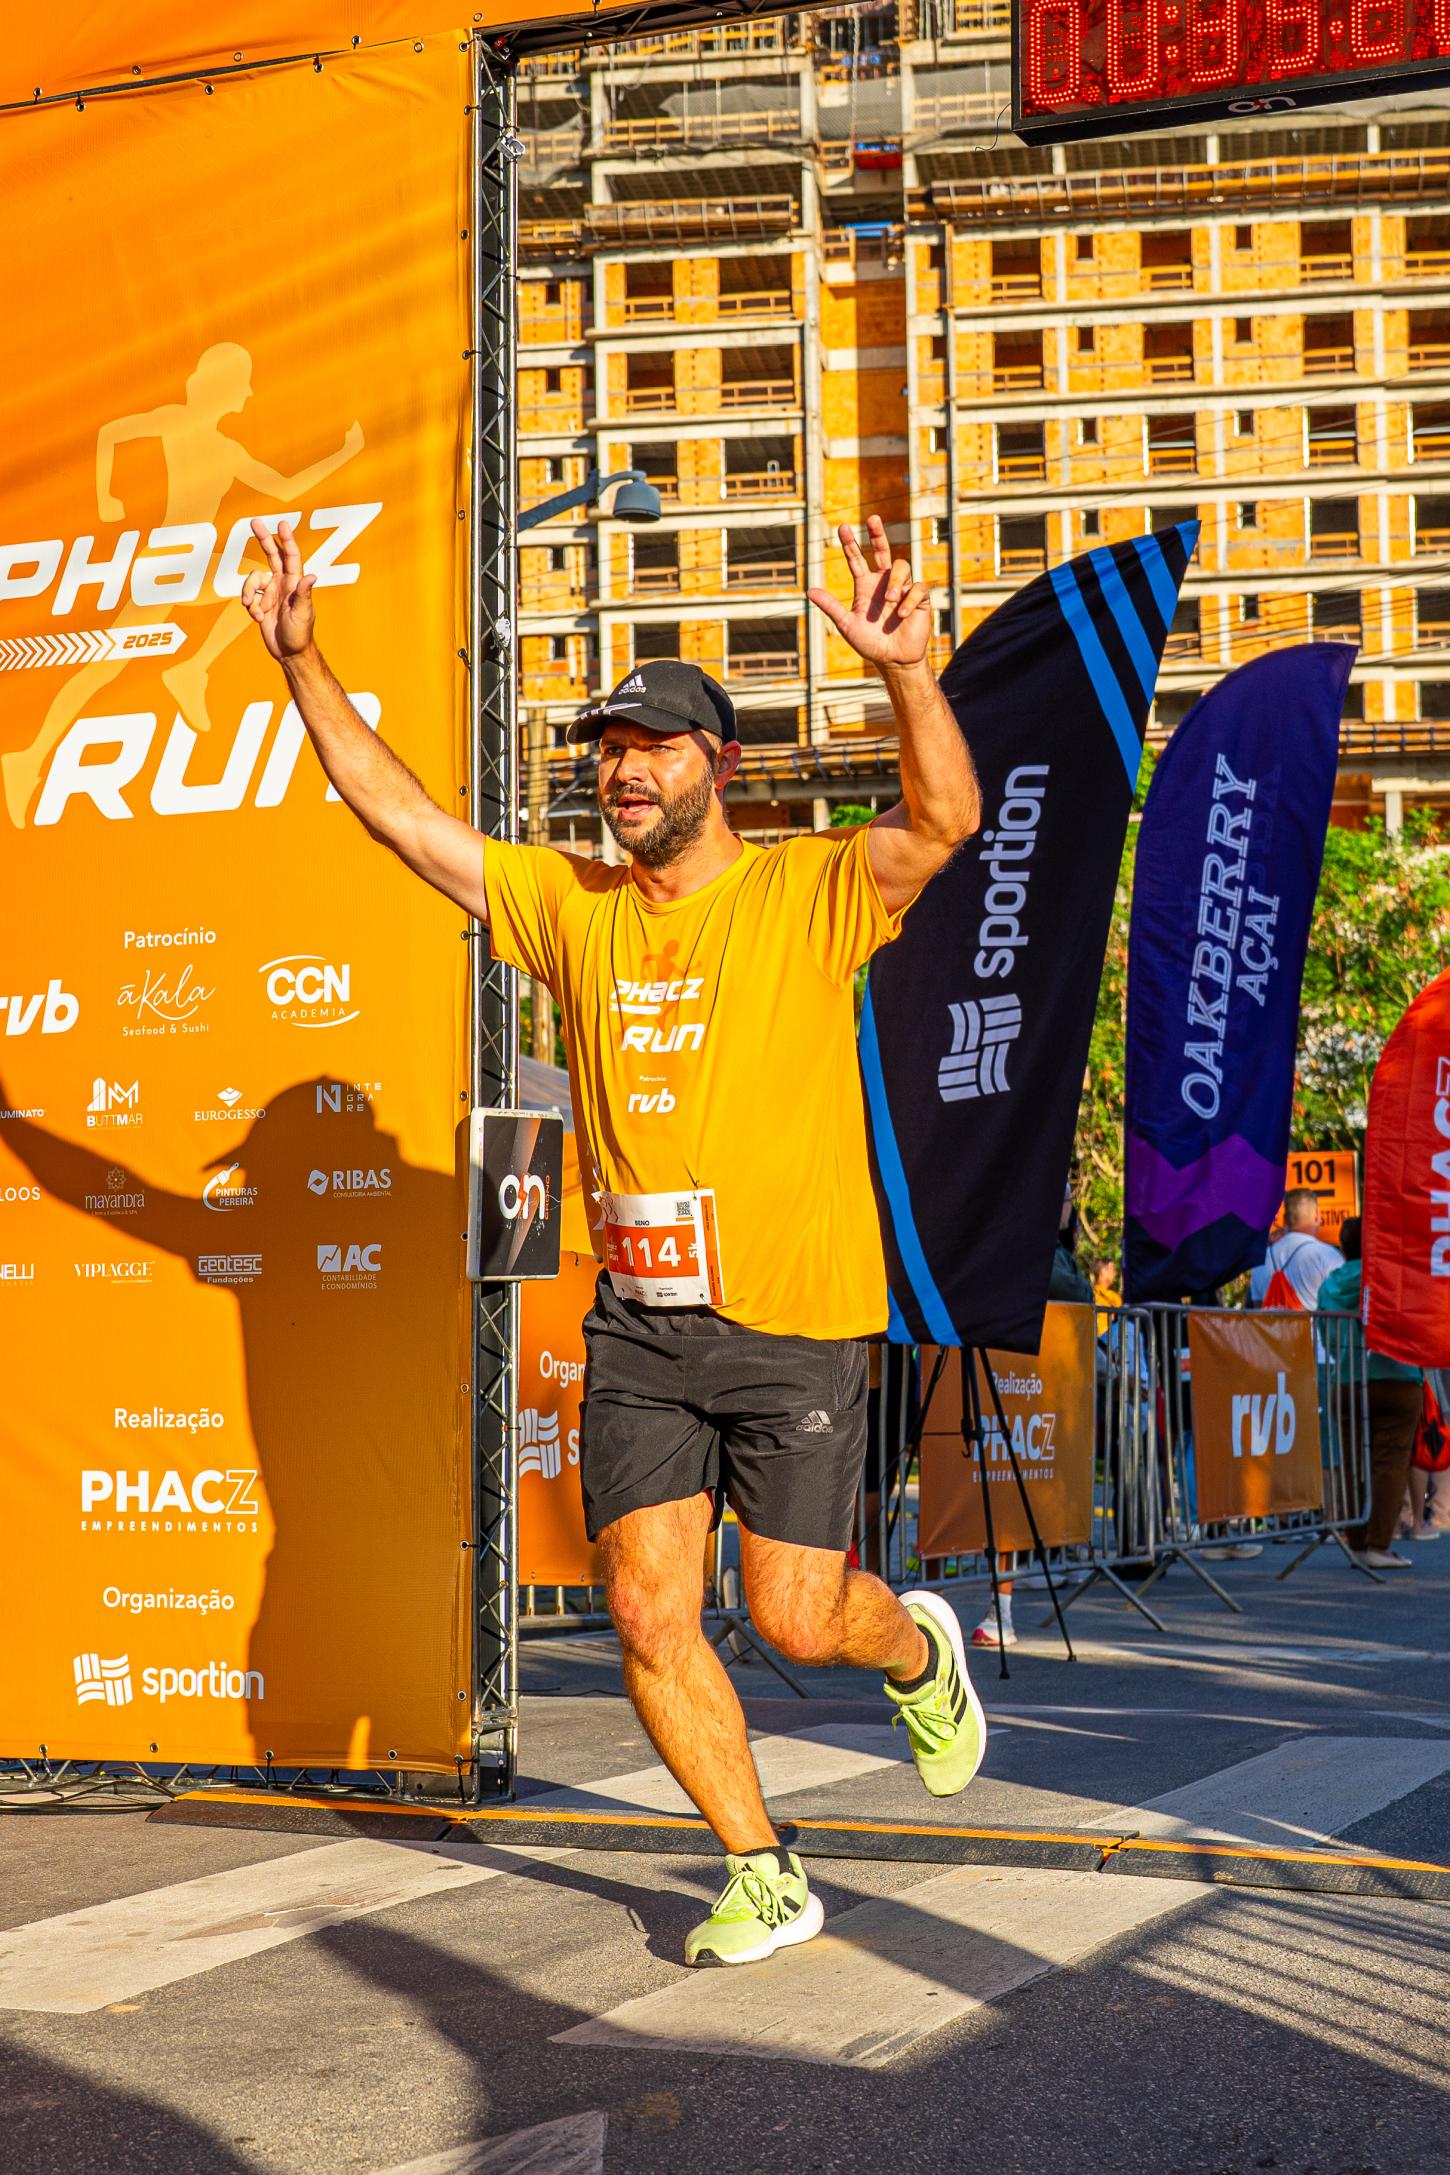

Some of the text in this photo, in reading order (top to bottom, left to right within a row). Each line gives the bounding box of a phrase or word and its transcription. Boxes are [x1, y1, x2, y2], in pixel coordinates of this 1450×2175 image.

[122, 631, 173, 649] 2025
[618, 685, 647, 695] adidas
[974, 764, 1050, 979] sportion
[124, 927, 217, 949] Patrocínio
[1180, 752, 1256, 1121] OAKBERRY
[266, 963, 350, 1006] CCN
[271, 1007, 346, 1020] ACADEMIA
[122, 1023, 210, 1037] Seafood & Sushi
[621, 1023, 705, 1053] RUN
[346, 1082, 382, 1091] INTE
[346, 1104, 364, 1112] RE
[628, 1088, 676, 1113] rvb
[86, 1113, 143, 1127] BUTTMAR
[194, 1108, 266, 1122] EUROGESSO
[332, 1168, 392, 1190] RIBAS
[1291, 1159, 1335, 1184] 101
[215, 1187, 258, 1197] PINTURAS
[219, 1197, 254, 1207] PEREIRA
[498, 1174, 545, 1220] on
[342, 1243, 382, 1272] AC
[621, 1236, 682, 1268] 114
[207, 1276, 254, 1285] Fundações
[322, 1273, 377, 1282] CONTABILIDADE
[114, 1407, 224, 1433] Realização
[1230, 1373, 1296, 1457] rvb
[796, 1422, 834, 1433] adidas
[81, 1469, 258, 1515] PHACZ
[81, 1520, 258, 1533] EMPREENDIMENTOS
[102, 1586, 235, 1615] Organização
[141, 1660, 265, 1704] sportion
